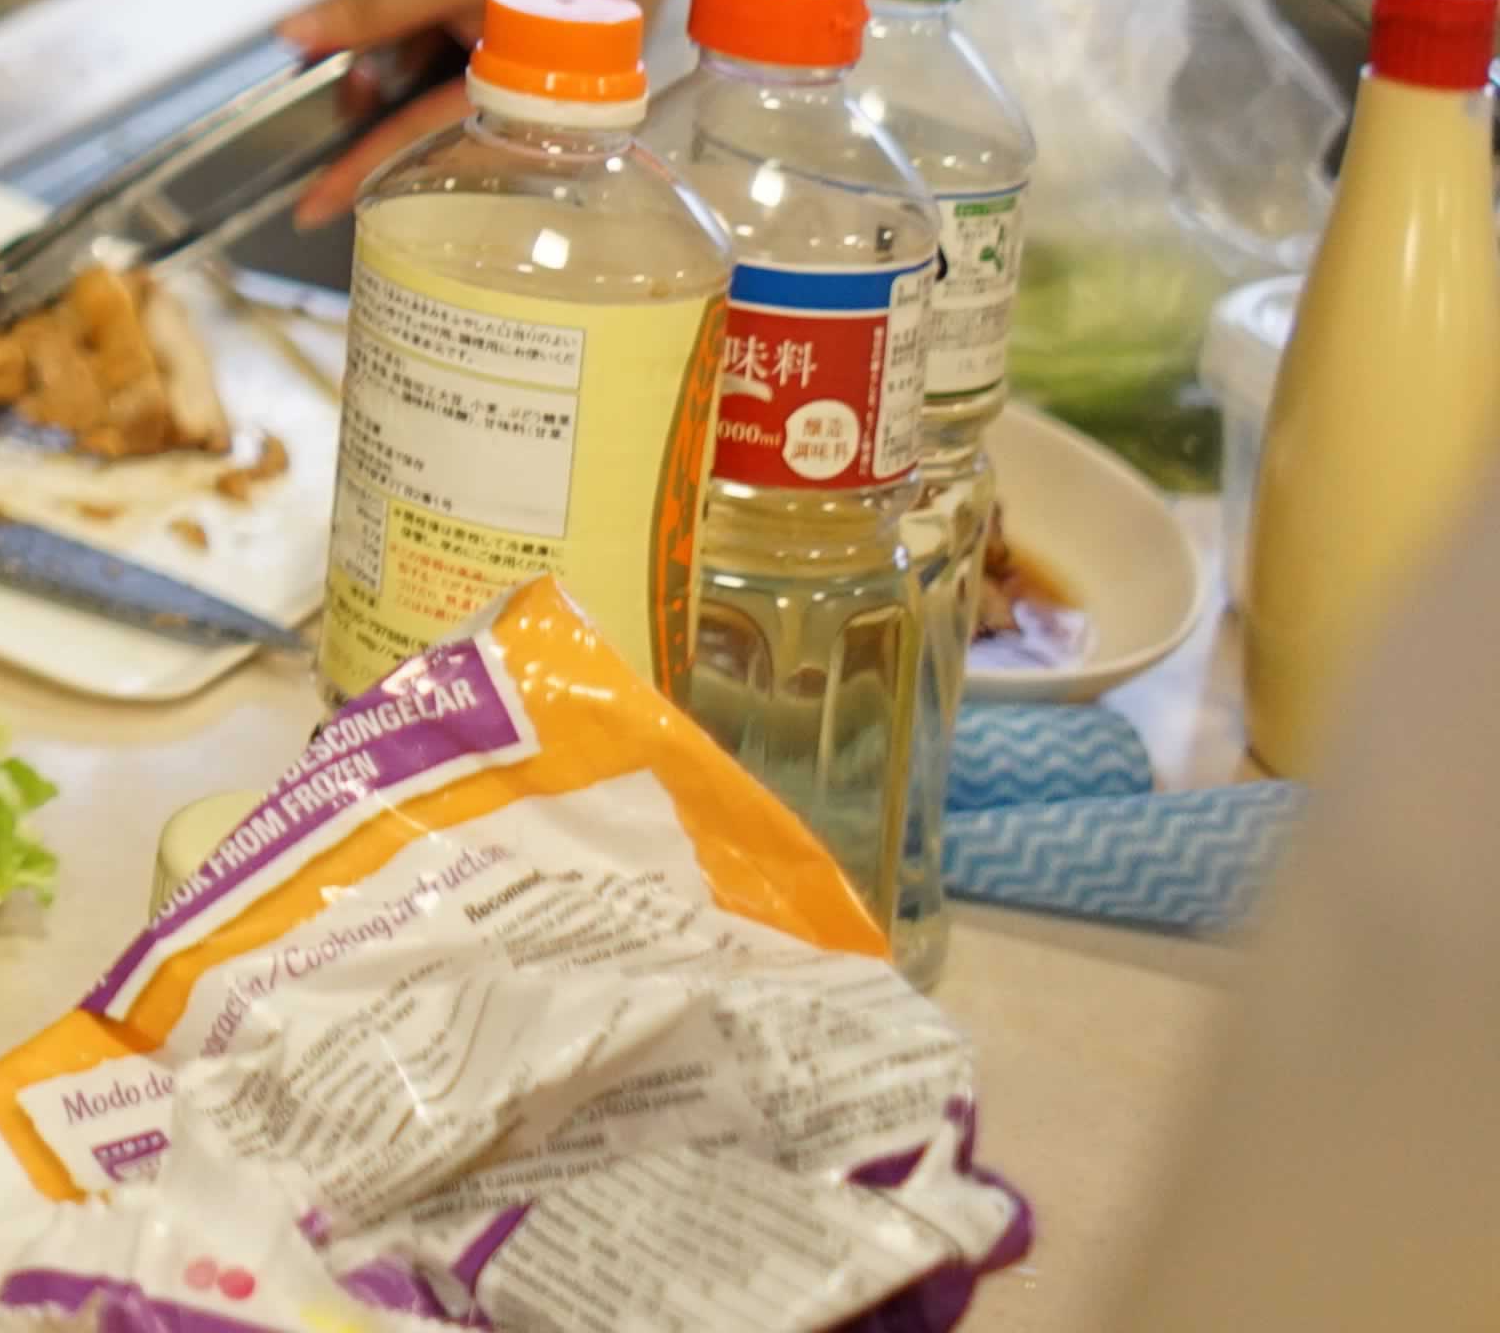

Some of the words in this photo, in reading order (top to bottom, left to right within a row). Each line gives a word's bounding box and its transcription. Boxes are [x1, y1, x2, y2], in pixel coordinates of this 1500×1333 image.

[208, 806, 289, 879] FROM
[279, 749, 381, 823] FROZEN
[61, 1077, 141, 1127] Modo
